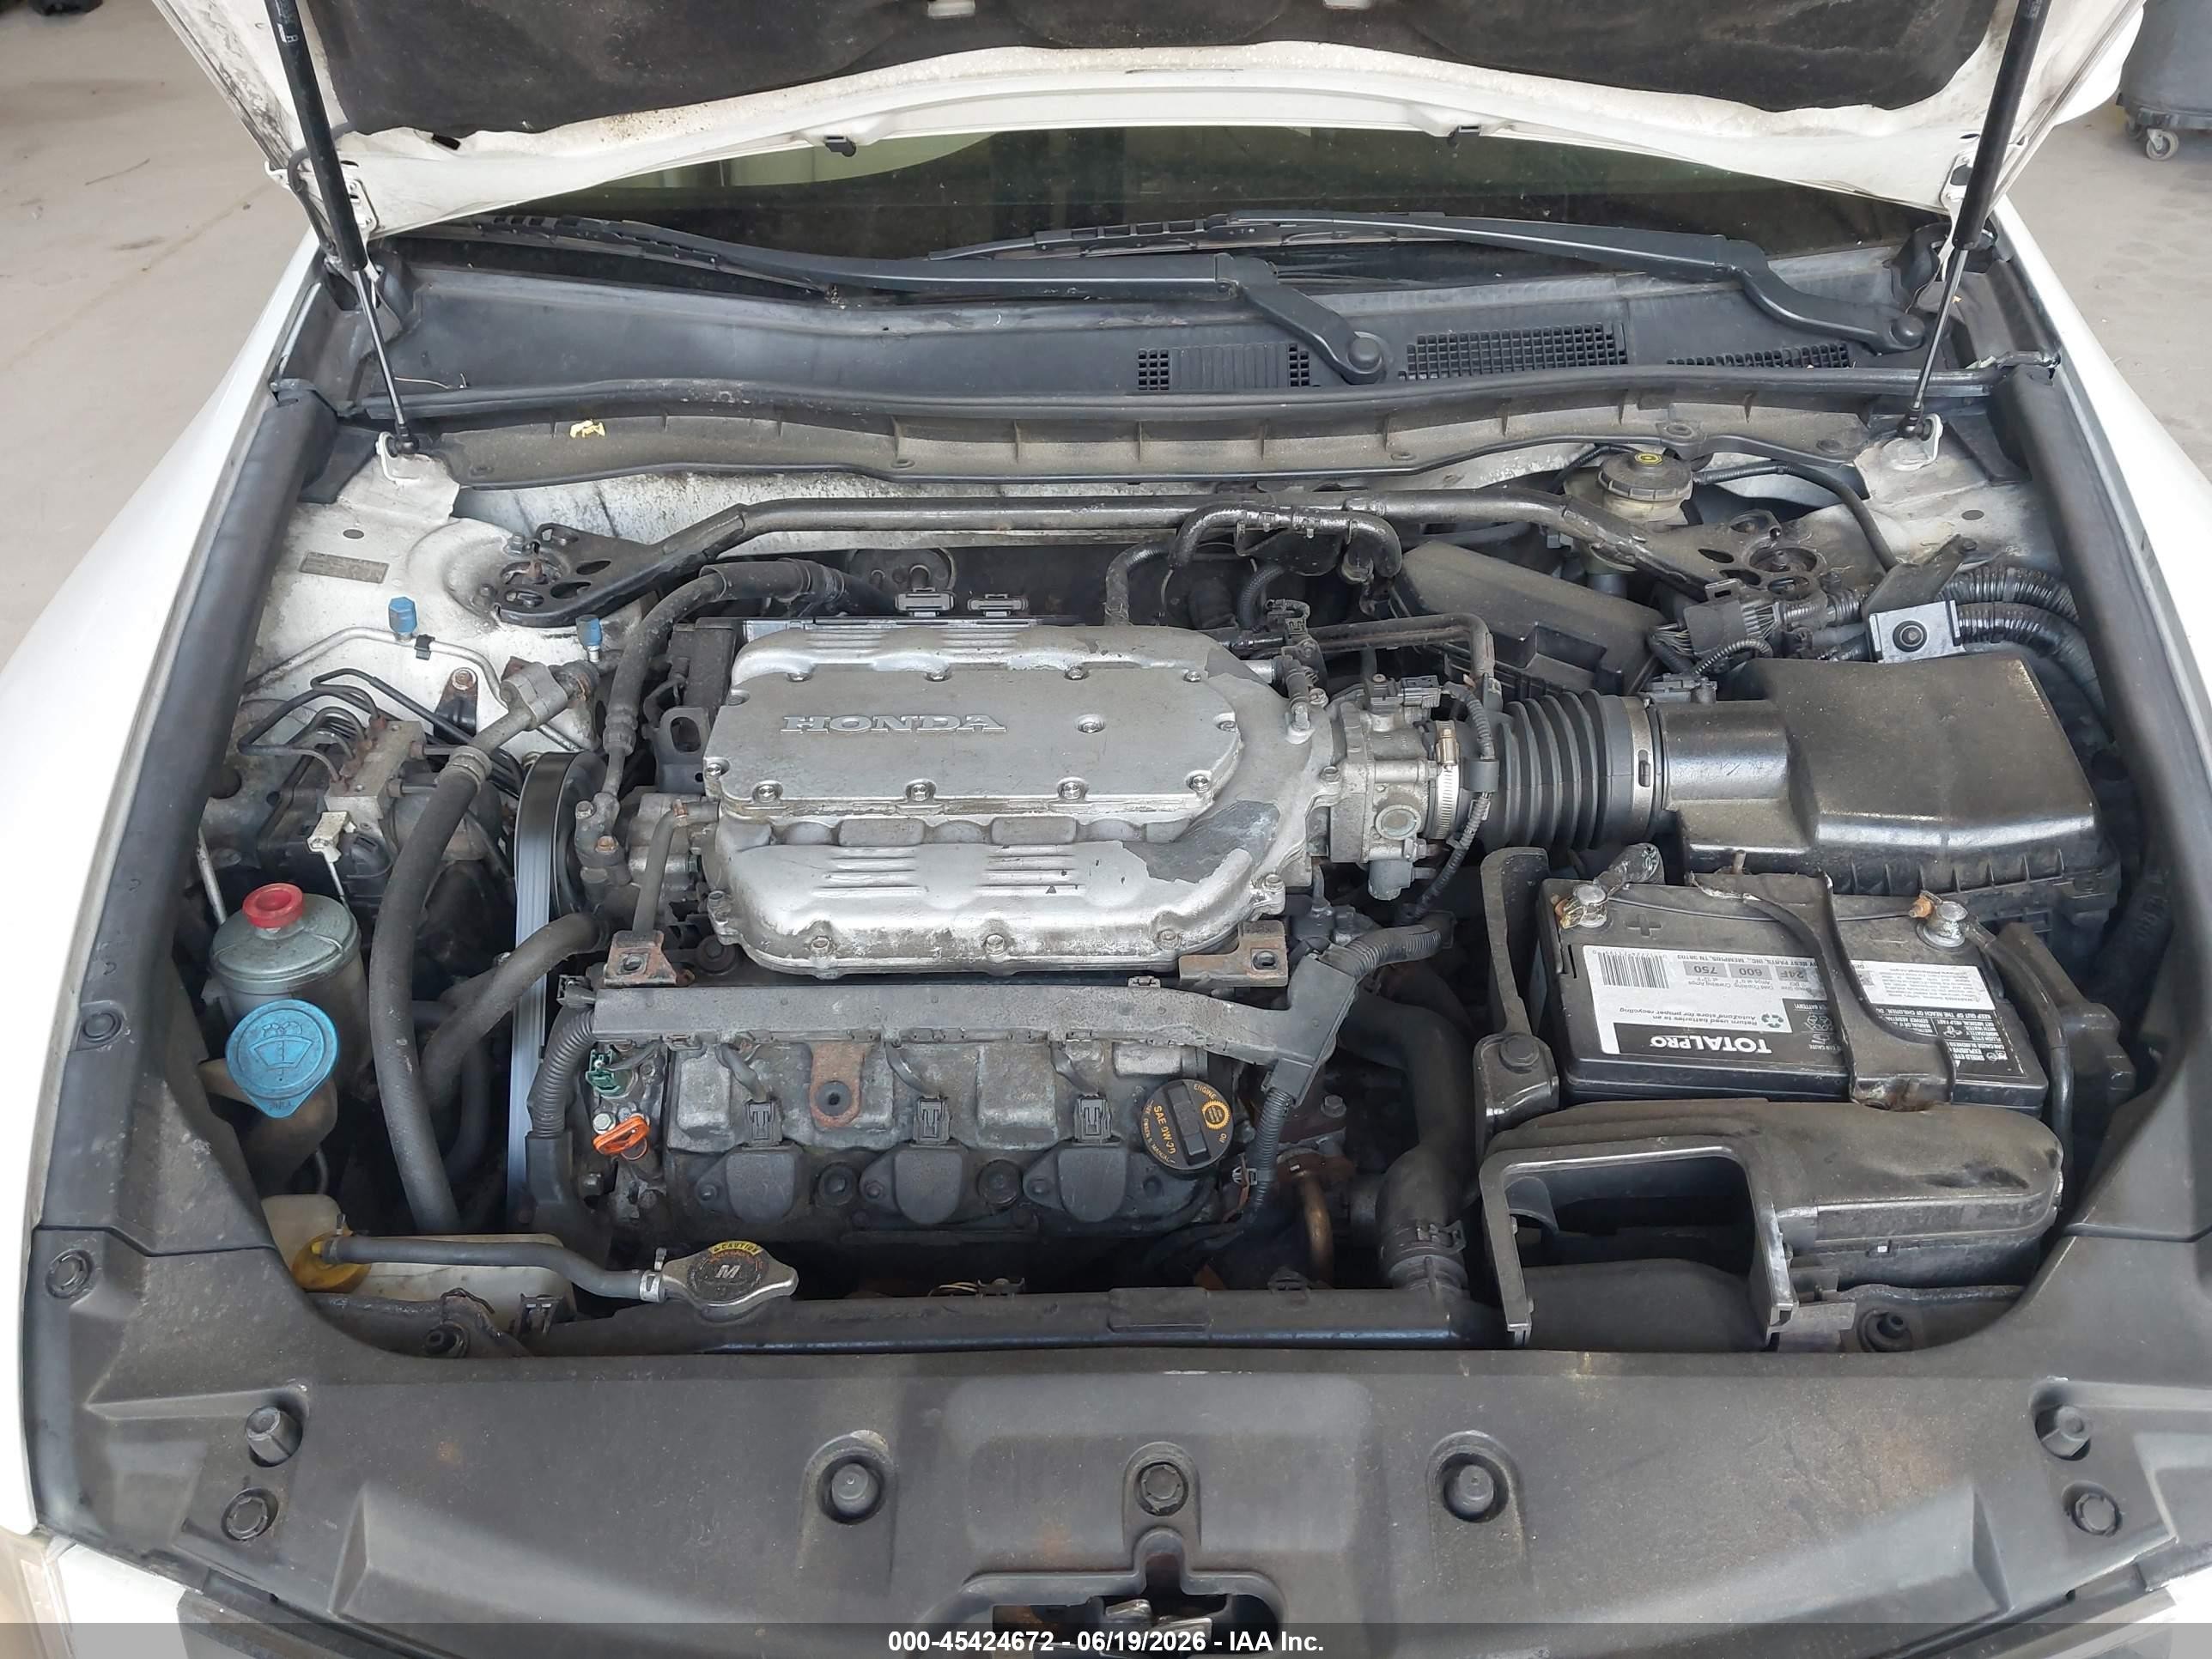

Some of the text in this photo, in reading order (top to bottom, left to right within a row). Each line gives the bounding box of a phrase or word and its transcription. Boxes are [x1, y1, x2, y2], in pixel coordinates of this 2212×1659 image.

[780, 714, 1006, 734] HONDA
[1693, 966, 1718, 975] 750
[1739, 968, 1763, 976] 600
[1780, 970, 1804, 979] 24F
[1650, 1035, 1772, 1054] TOTALPRO
[1194, 1084, 1217, 1100] ENGINE
[1153, 1105, 1167, 1125] SAE
[1218, 1133, 1227, 1144] OIL
[720, 1242, 758, 1254] CAUTION
